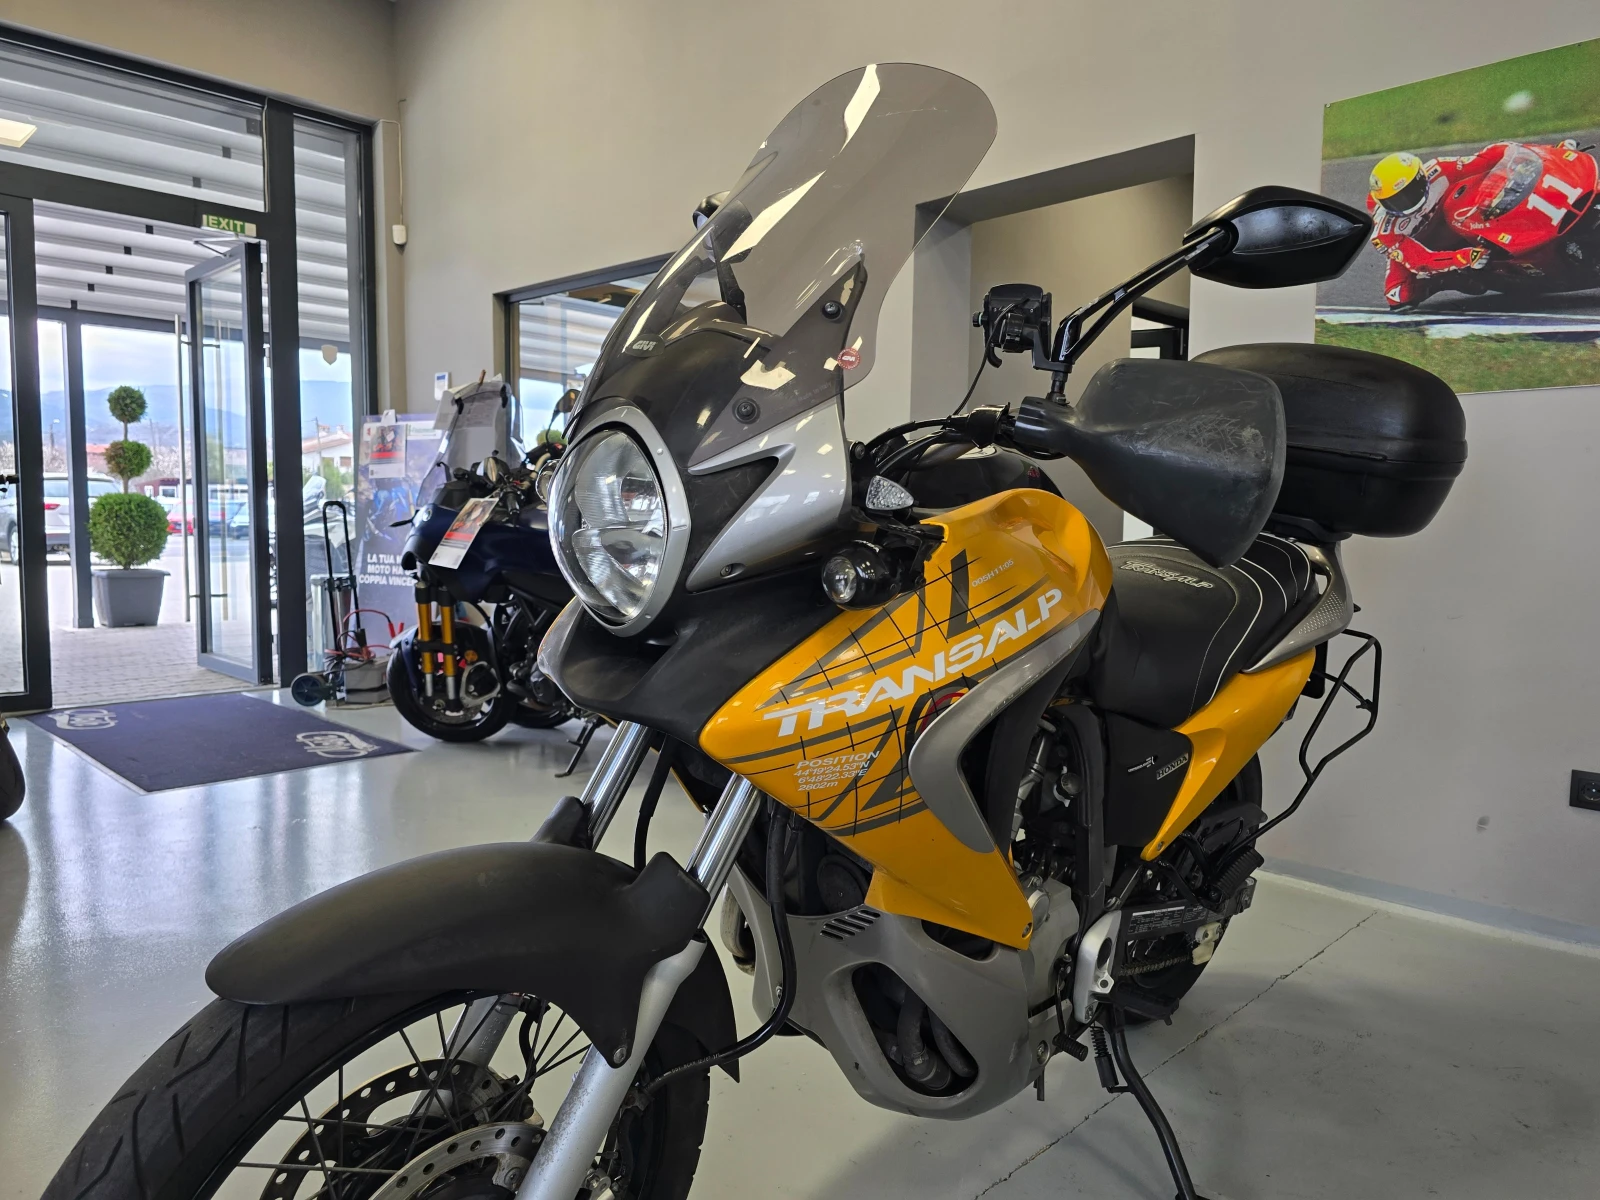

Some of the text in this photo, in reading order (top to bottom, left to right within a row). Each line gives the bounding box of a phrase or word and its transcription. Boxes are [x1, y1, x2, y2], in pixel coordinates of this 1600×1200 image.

[1527, 174, 1583, 227] 11
[208, 215, 243, 233] EXIT
[633, 340, 657, 351] GIVI
[367, 553, 378, 564] LA
[379, 553, 395, 564] TUA
[367, 564, 391, 574] MOTO
[392, 565, 403, 575] HA
[359, 574, 387, 585] COPPIA
[763, 587, 1063, 738] TRANSALP
[796, 750, 880, 770] POSITION
[1156, 754, 1188, 779] HONDA
[797, 781, 838, 791] 2802m
